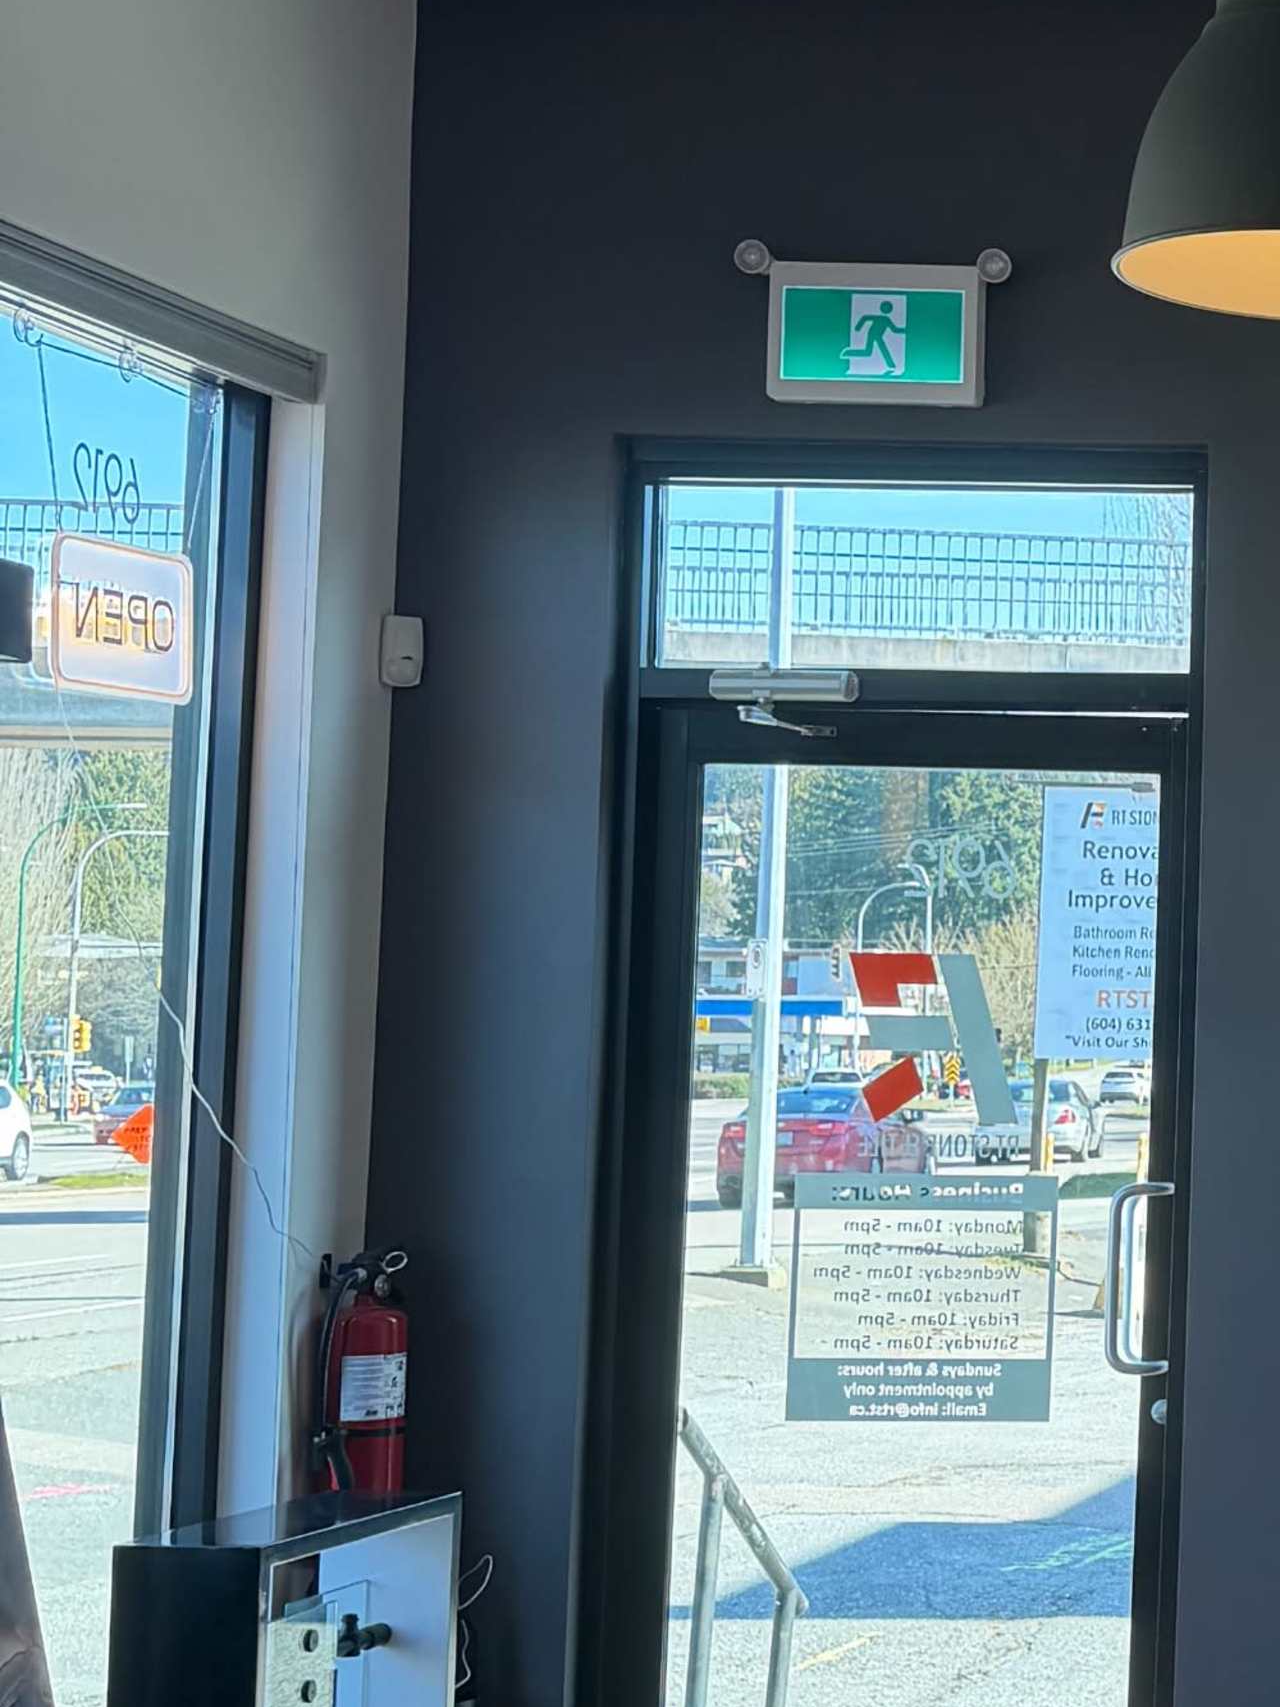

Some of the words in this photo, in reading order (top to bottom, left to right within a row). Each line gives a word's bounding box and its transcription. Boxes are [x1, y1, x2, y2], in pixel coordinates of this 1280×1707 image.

[1100, 867, 1115, 886] &
[1073, 925, 1137, 939] Bathroom
[1072, 945, 1121, 959] Kitchen
[1072, 965, 1124, 980] Flooring
[1086, 1018, 1122, 1033] (604)
[1126, 1019, 1151, 1031] 631
[1105, 1037, 1128, 1048] Our
